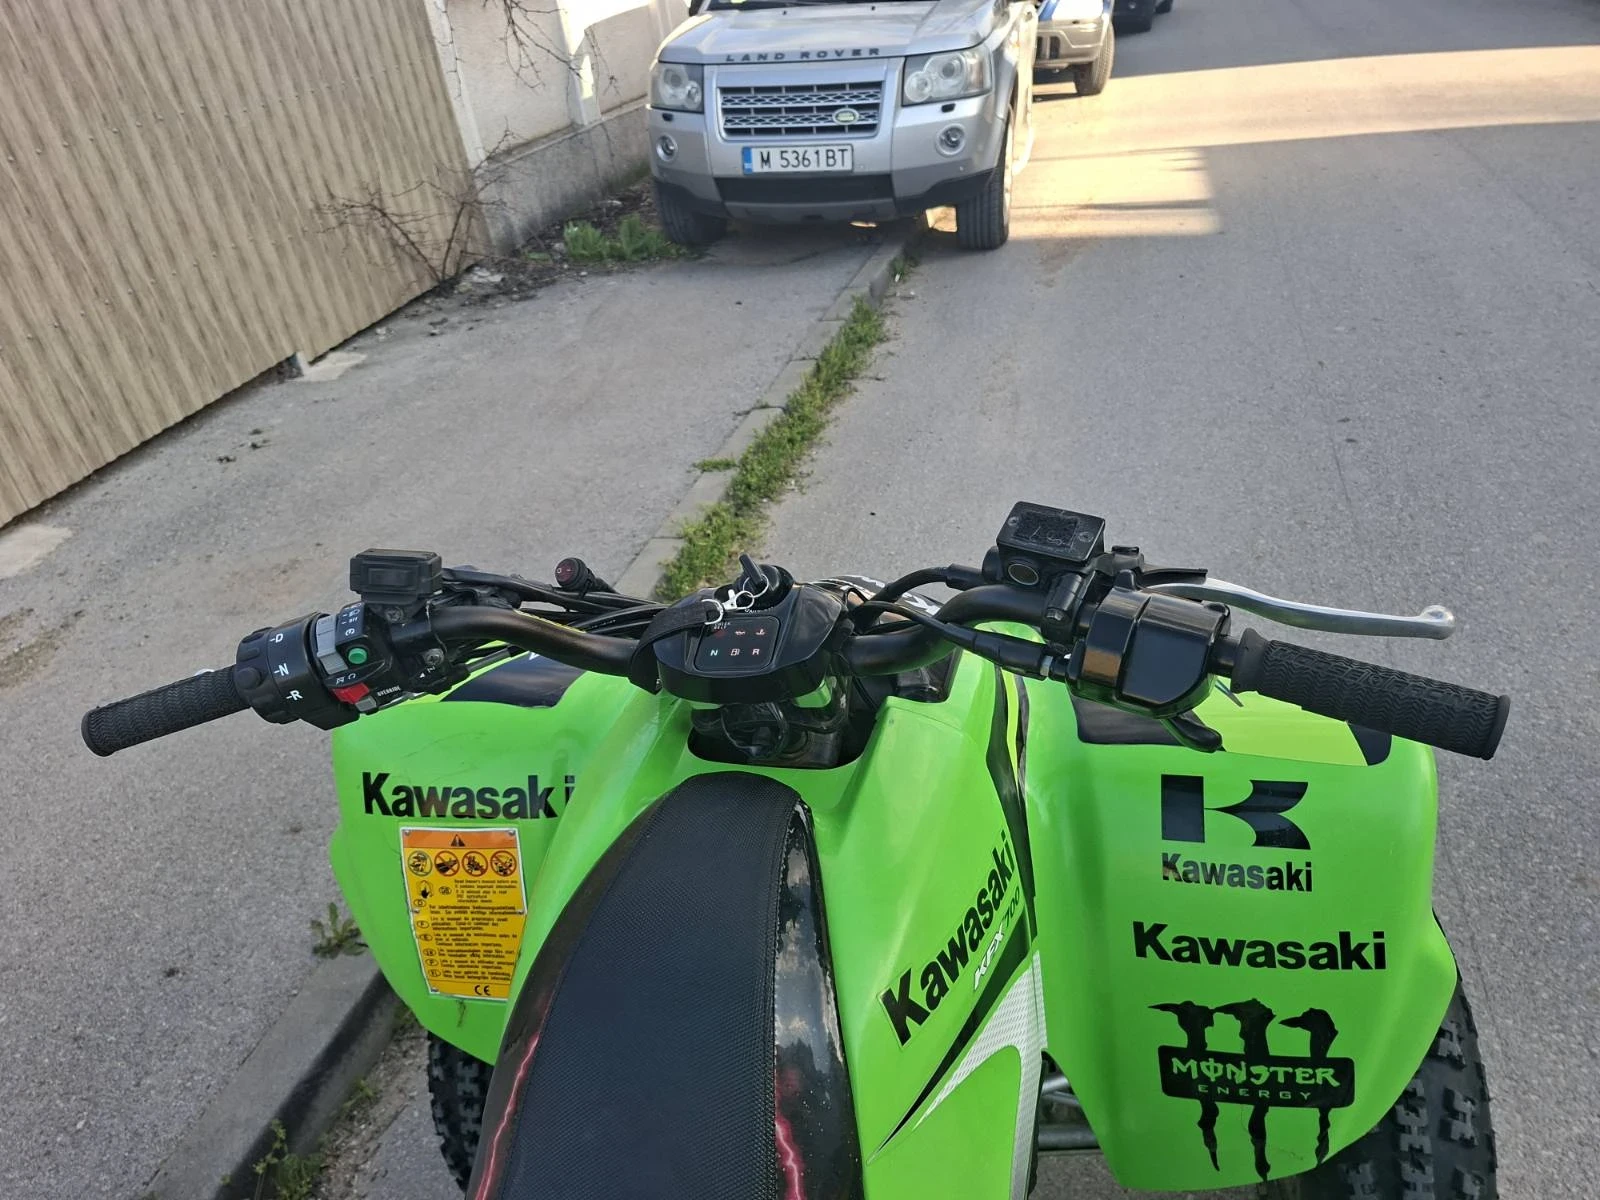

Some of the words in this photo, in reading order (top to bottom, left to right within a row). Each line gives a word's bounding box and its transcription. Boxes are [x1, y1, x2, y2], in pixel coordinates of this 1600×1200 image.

[726, 52, 786, 62] LAND
[800, 47, 881, 59] ROVER
[760, 150, 772, 169] M
[780, 148, 848, 168] 5361BT
[751, 648, 760, 656] R
[279, 662, 289, 676] N
[290, 689, 303, 701] R
[362, 771, 576, 820] Kawasaki
[1161, 852, 1313, 892] Kawasaki
[1002, 886, 1020, 928] 700
[880, 829, 1015, 1046] Kawasaki
[1132, 920, 1387, 970] Kawasaki
[1171, 1057, 1340, 1088] MONSTER
[1197, 1084, 1312, 1100] ENERGY
